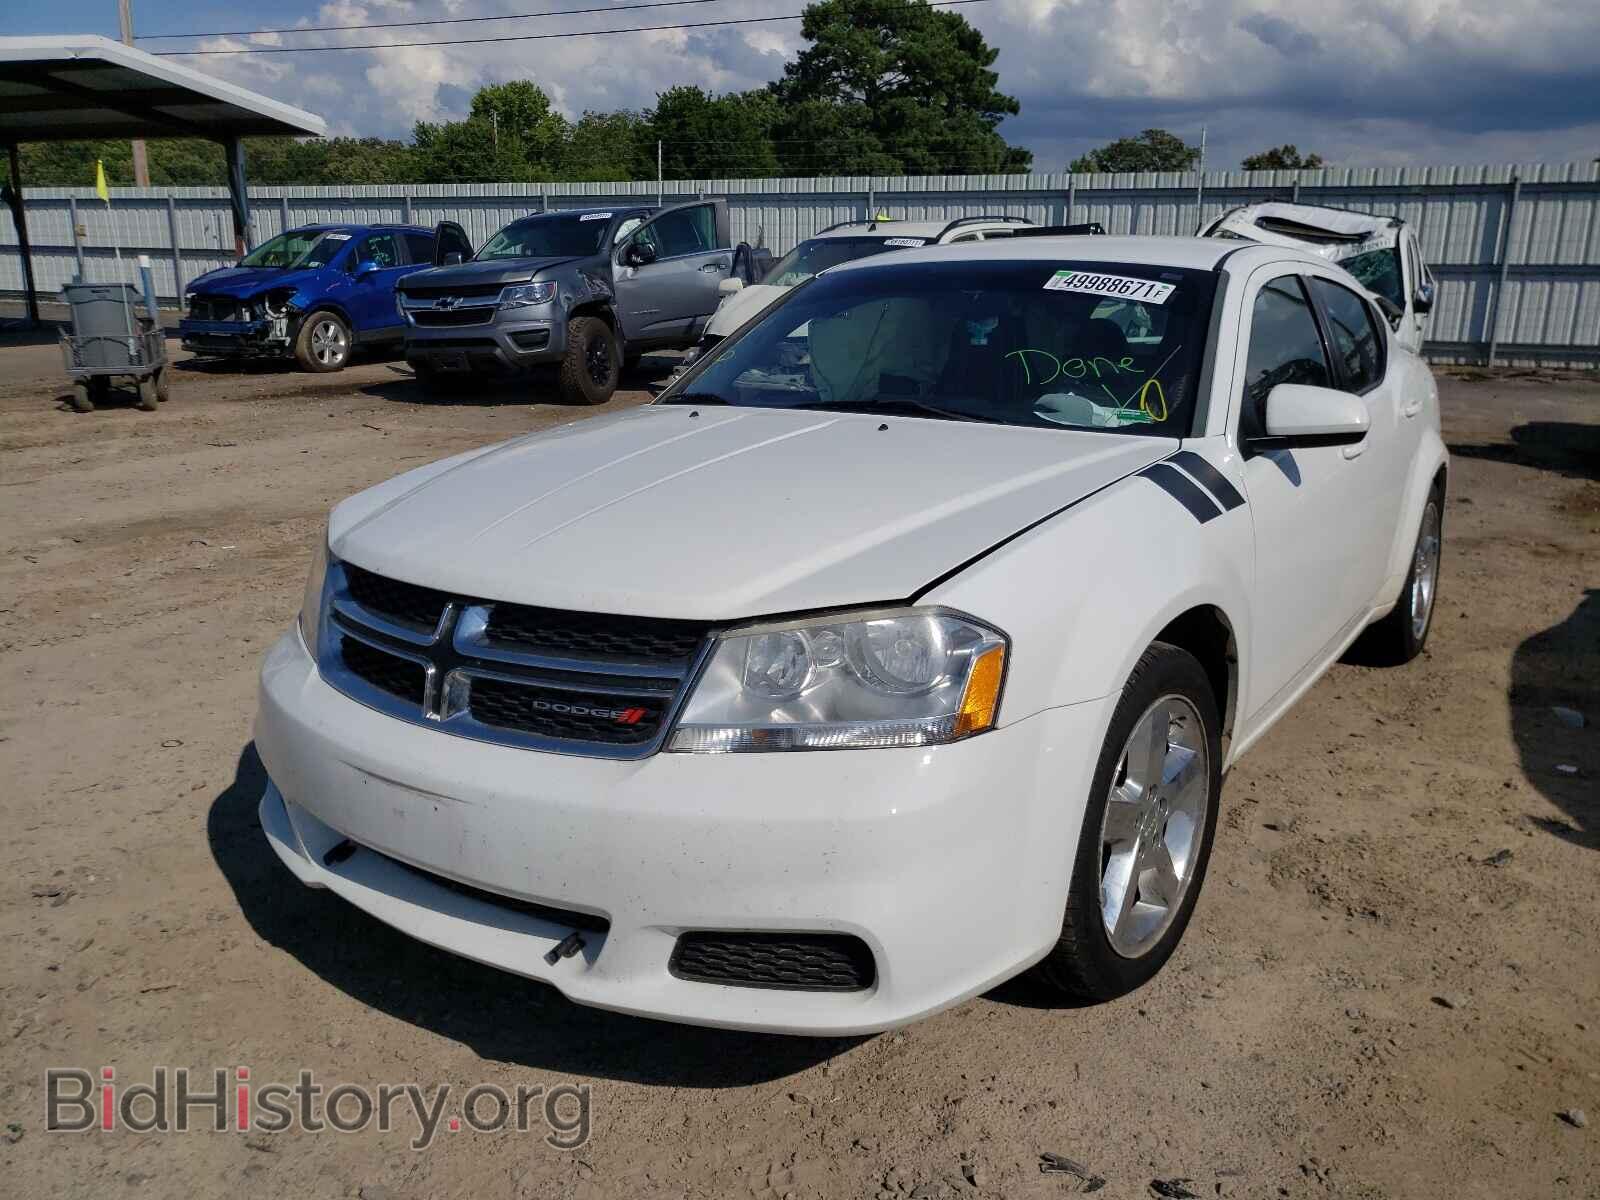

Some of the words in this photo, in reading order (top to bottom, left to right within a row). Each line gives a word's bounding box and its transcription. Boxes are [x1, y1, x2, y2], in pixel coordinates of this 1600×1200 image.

[1063, 273, 1156, 298] 49988671
[1004, 349, 1145, 384] Done
[532, 700, 628, 720] DODGE
